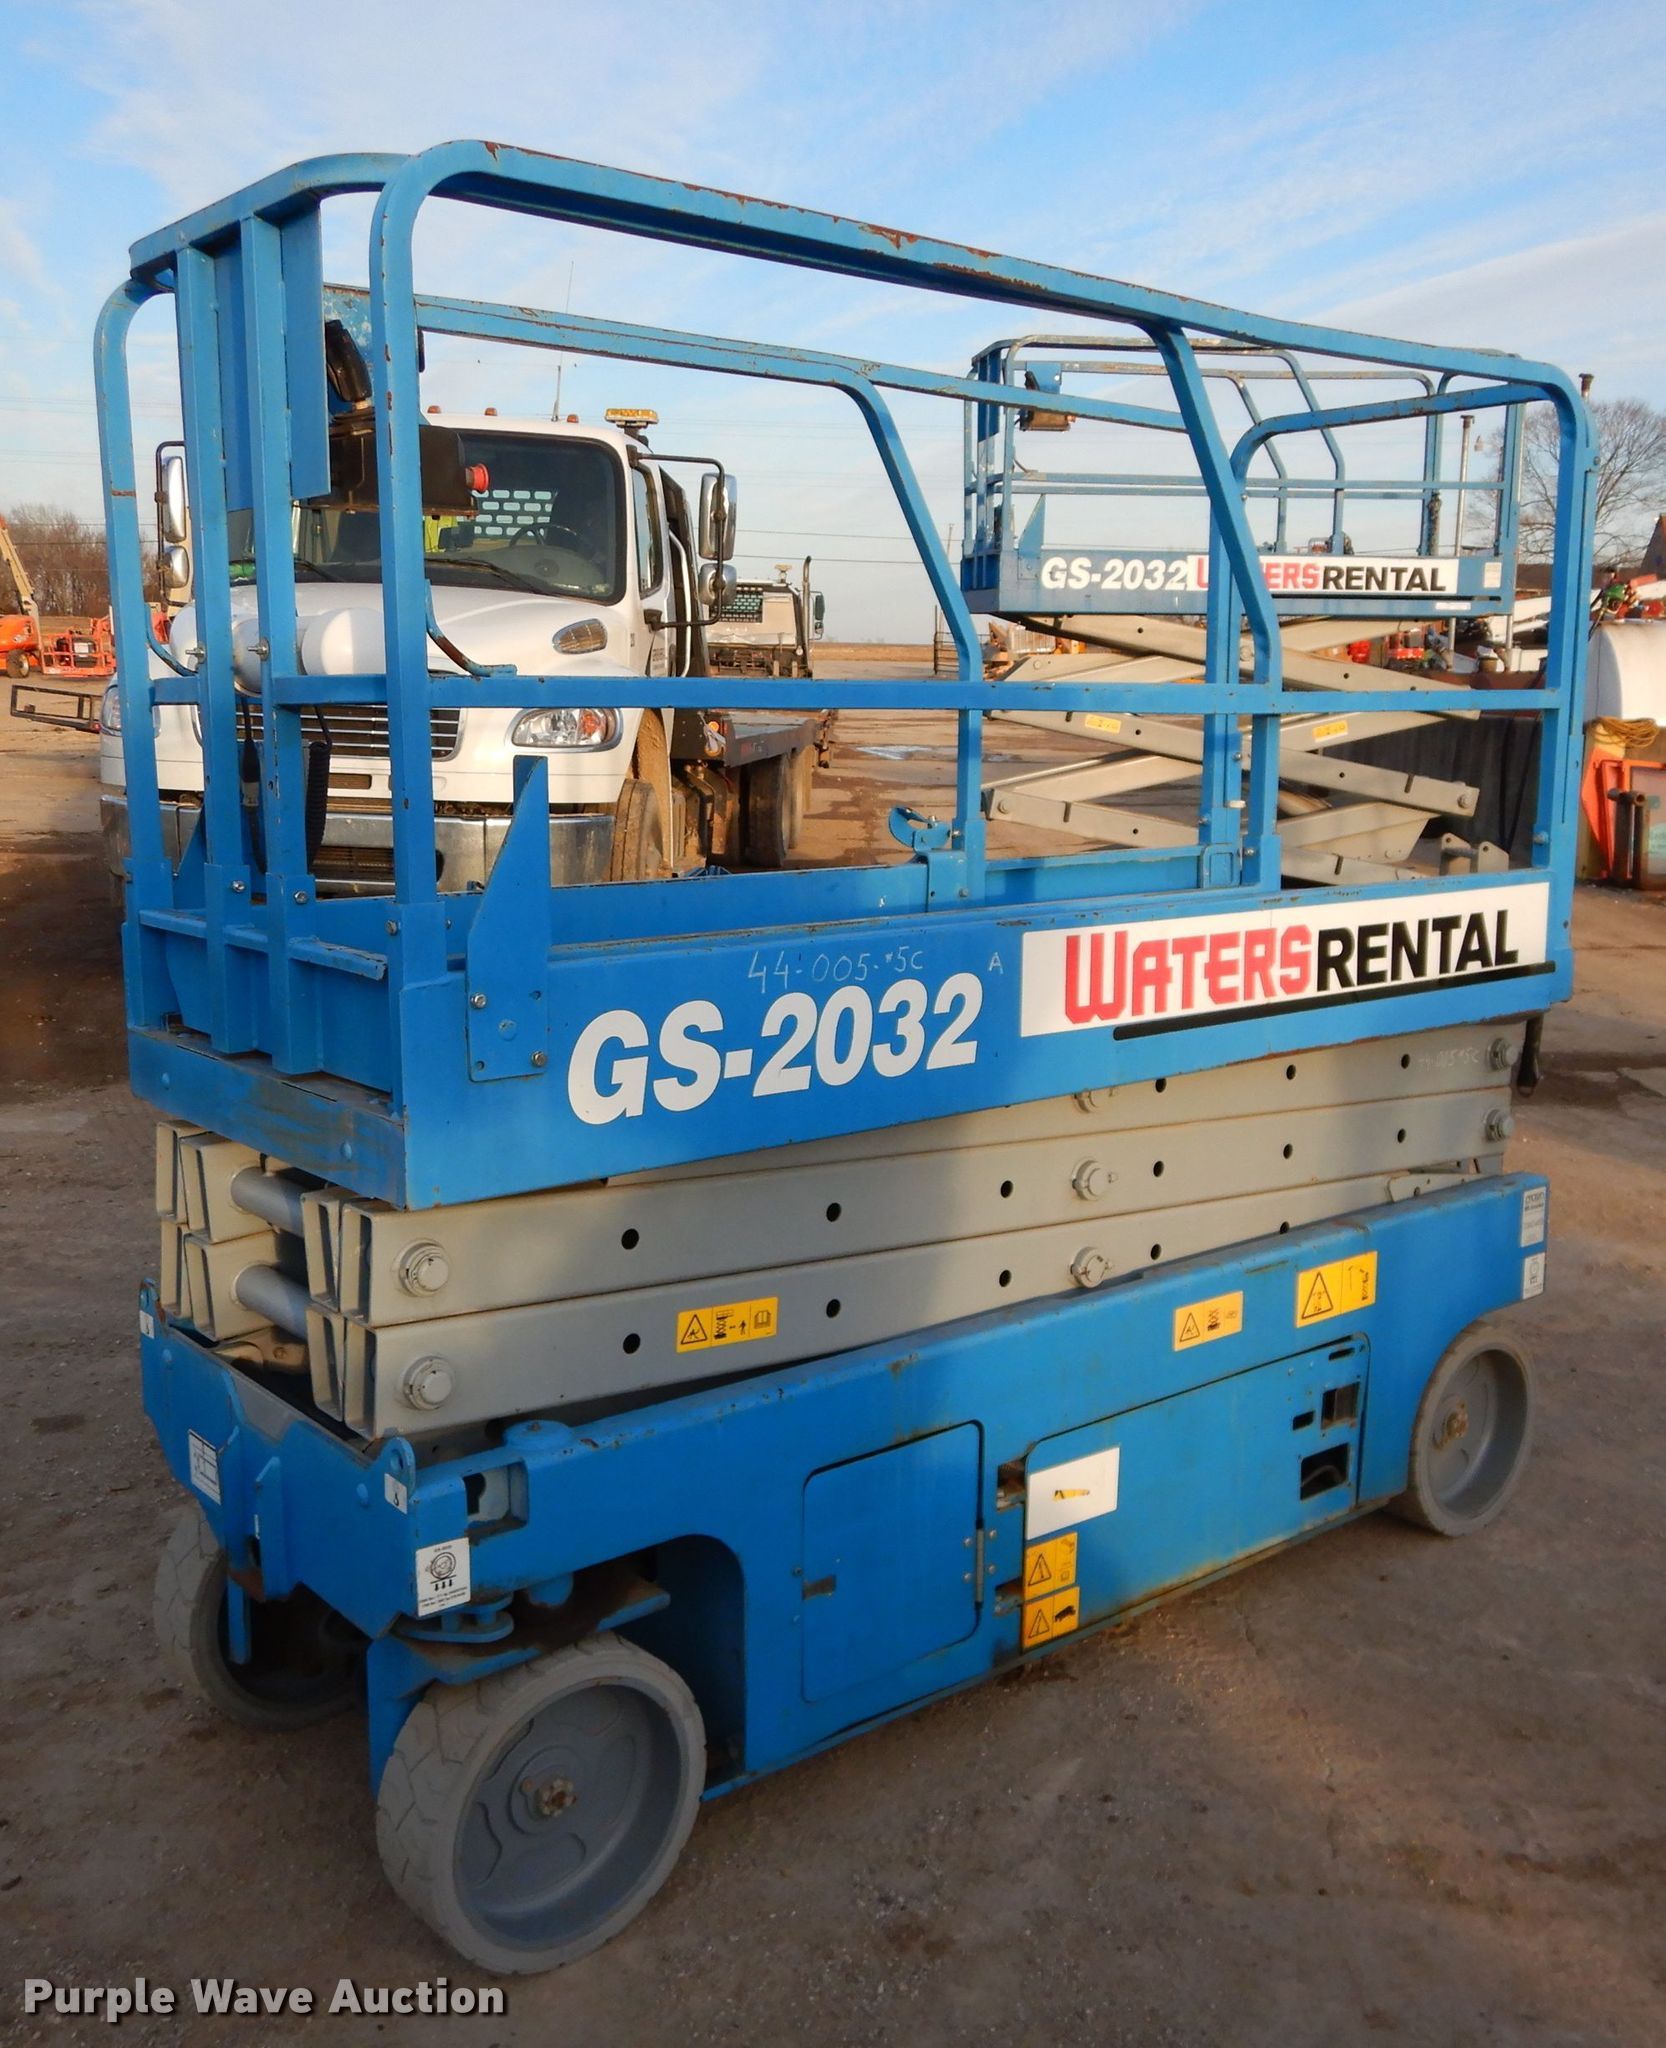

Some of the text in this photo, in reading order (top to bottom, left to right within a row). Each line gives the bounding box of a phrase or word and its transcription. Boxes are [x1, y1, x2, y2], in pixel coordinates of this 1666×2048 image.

[1041, 557, 1187, 590] GS-2032
[1322, 565, 1446, 592] RENTAL
[1064, 909, 1519, 1024] WATERS RENTAL
[567, 972, 984, 1125] GS-2032
